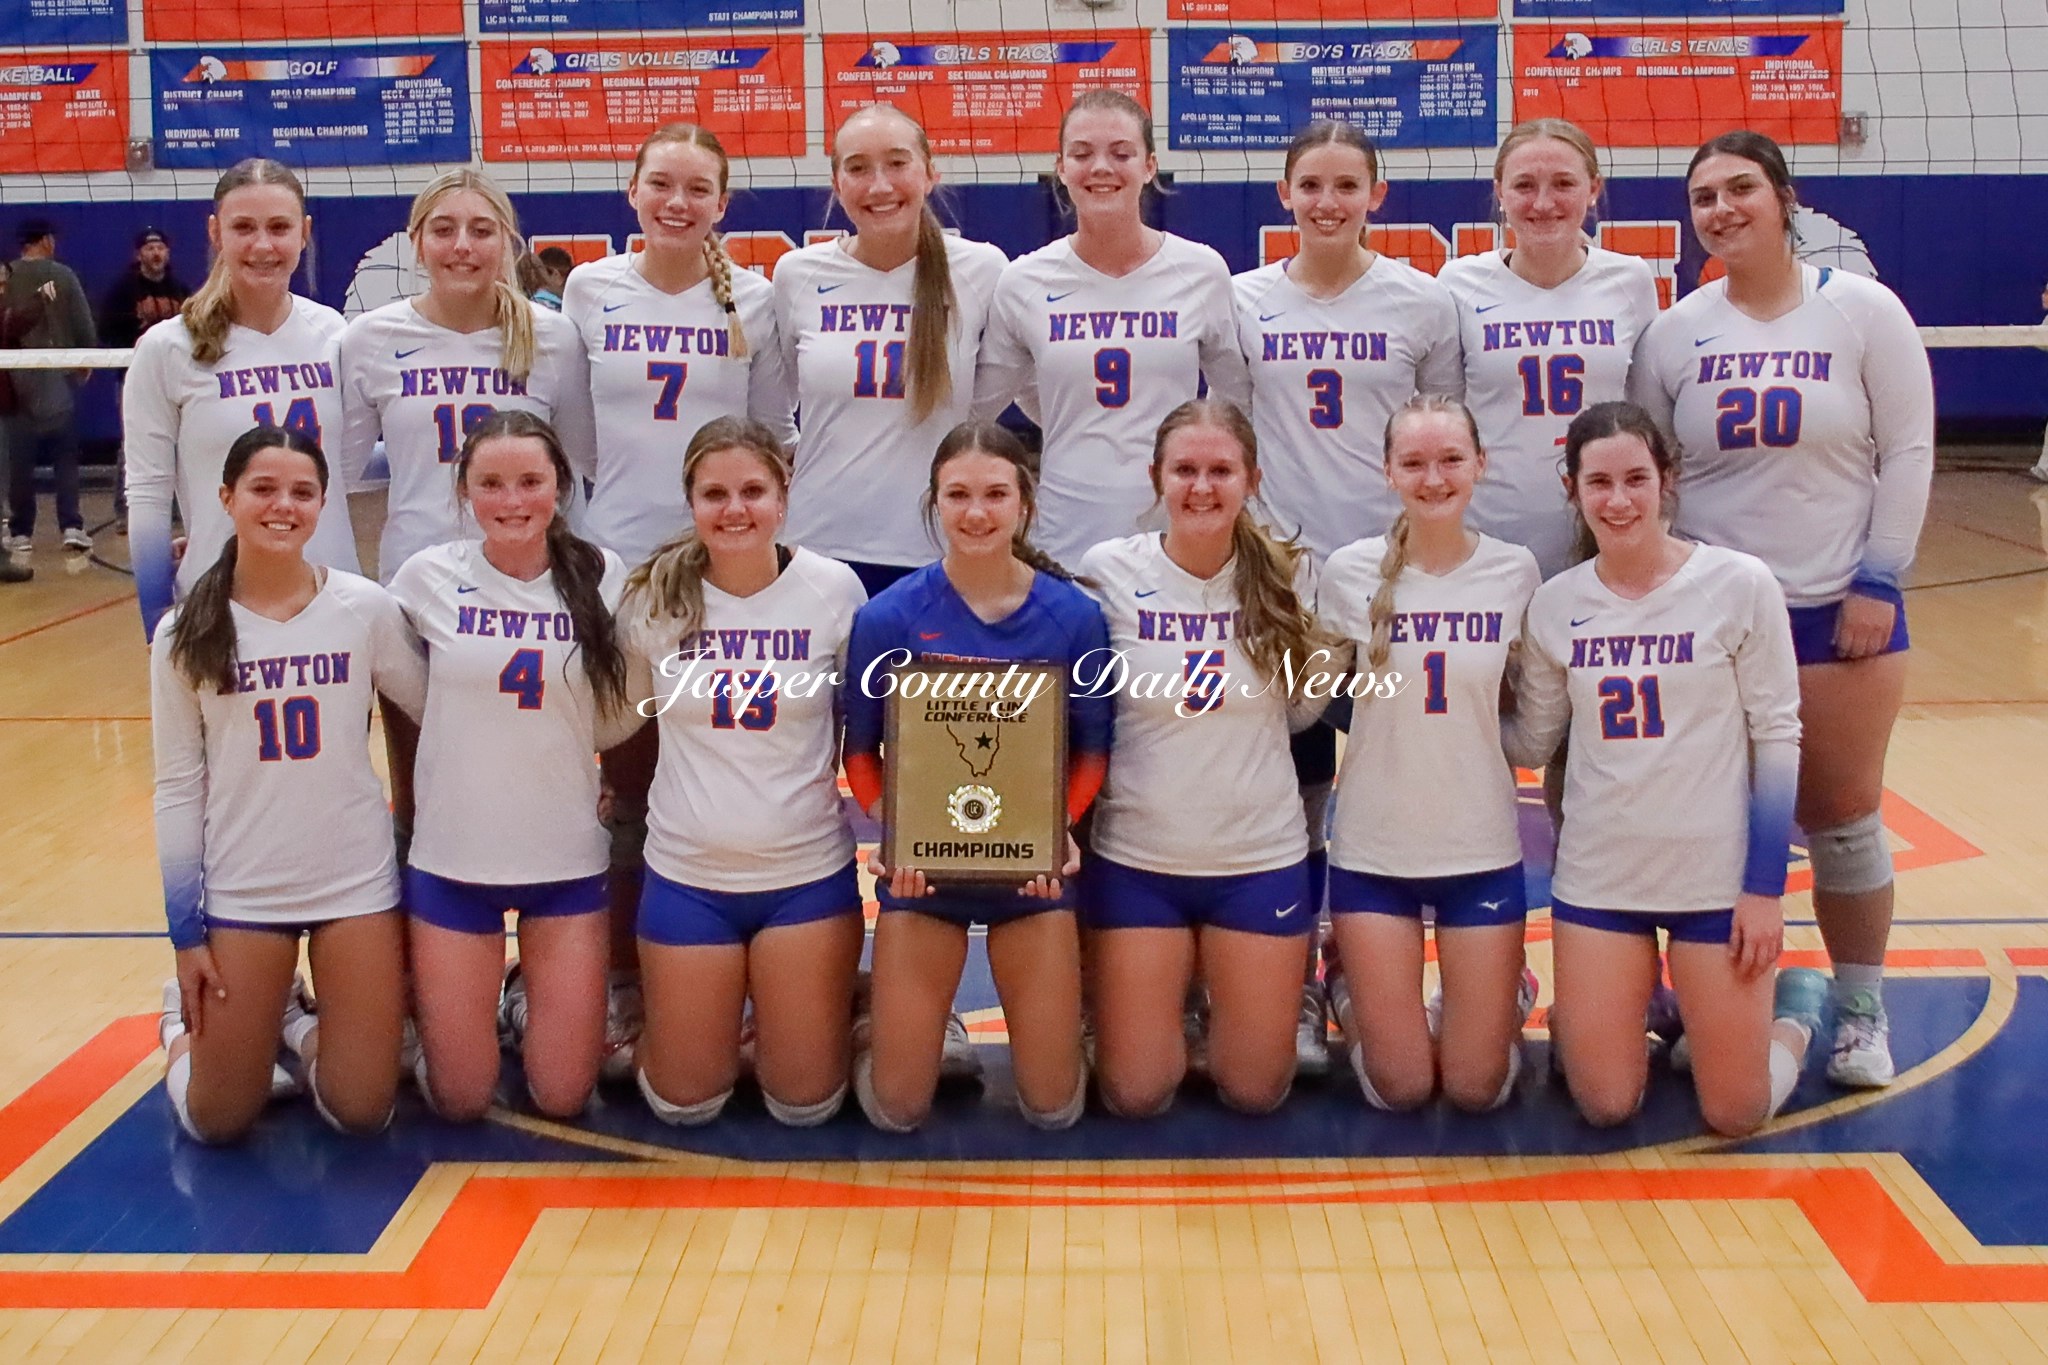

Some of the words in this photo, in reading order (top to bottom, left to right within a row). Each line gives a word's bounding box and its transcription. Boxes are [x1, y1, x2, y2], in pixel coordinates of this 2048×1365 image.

[732, 10, 778, 20] CHAMPIONS
[934, 46, 992, 61] GIRLS
[997, 43, 1059, 60] TRACK
[1292, 44, 1345, 59] BOYS
[1350, 42, 1414, 59] TRACK
[1630, 40, 1683, 54] GIRLS
[1687, 39, 1750, 53] TENNIS
[565, 53, 622, 68] GIRLS
[627, 50, 740, 67] VOLLEYBALL
[1426, 63, 1449, 73] STATE
[1450, 62, 1476, 72] FINISH
[1764, 59, 1815, 70] INDIVIDUAL
[288, 60, 338, 76] GOLF
[836, 71, 894, 81] CONFERENCE
[896, 70, 934, 81] CHAMPS
[947, 70, 993, 80] SECTIONAL
[993, 69, 1048, 80] CHAMPIONS
[1078, 68, 1105, 78] STATE
[1106, 67, 1137, 77] FINISH
[1181, 65, 1228, 75] CONFERENCE
[1230, 66, 1275, 76] CHAMPIONS
[1311, 66, 1345, 76] DISTRICT
[1346, 65, 1392, 76] CHAMPIONS
[1524, 66, 1581, 77] CONFERENCE
[1585, 66, 1623, 76] CHAMPS
[1636, 65, 1679, 76] REGIONAL
[1681, 65, 1735, 76] CHAMPIONS
[395, 78, 443, 89] INDIVIDUAL
[495, 78, 551, 89] CONFERENCE
[555, 77, 591, 88] CHAMPS
[602, 77, 645, 87] REGIONAL
[647, 76, 700, 86] CHAMPIONS
[739, 74, 765, 84] STATE
[1566, 77, 1580, 87] LIC
[75, 89, 100, 99] STATE
[163, 89, 203, 99] DISTRICT
[206, 89, 244, 99] CHAMPS
[270, 88, 302, 98] APOLLO
[303, 86, 357, 97] CHAMPIONS
[1311, 97, 1351, 106] SECTIONAL
[1352, 96, 1397, 106] CHAMPIONS
[164, 128, 212, 139] INDIVIDUAL
[214, 127, 240, 138] STATE
[272, 126, 315, 138] REGIONAL
[316, 124, 369, 137] CHAMPIONS
[820, 304, 913, 332] NEWT
[1049, 311, 1178, 342] NEWTON
[604, 324, 729, 357] NEWTON
[1483, 319, 1615, 351] NEWTON
[1262, 332, 1388, 361] NEWTON
[854, 340, 907, 399] 11
[1698, 351, 1832, 384] NEWTON
[216, 361, 334, 399] NEWTON
[1094, 347, 1132, 409] 9
[1517, 353, 1585, 417] 16
[647, 360, 687, 421] 7
[1307, 368, 1344, 429] 3
[1716, 386, 1802, 451] 20
[1138, 609, 1240, 642] NEWT
[1390, 611, 1503, 643] EWTON
[1569, 631, 1695, 668] NEWTON
[499, 648, 545, 710] 4
[1183, 648, 1225, 712] 5
[1423, 651, 1448, 714] 1
[710, 669, 778, 732] 13
[926, 700, 979, 711] LITTLE
[1598, 675, 1666, 740] 21
[924, 711, 1028, 724] CONFERENCE
[253, 695, 321, 762] 10
[913, 841, 1034, 859] CHAMPIONS
